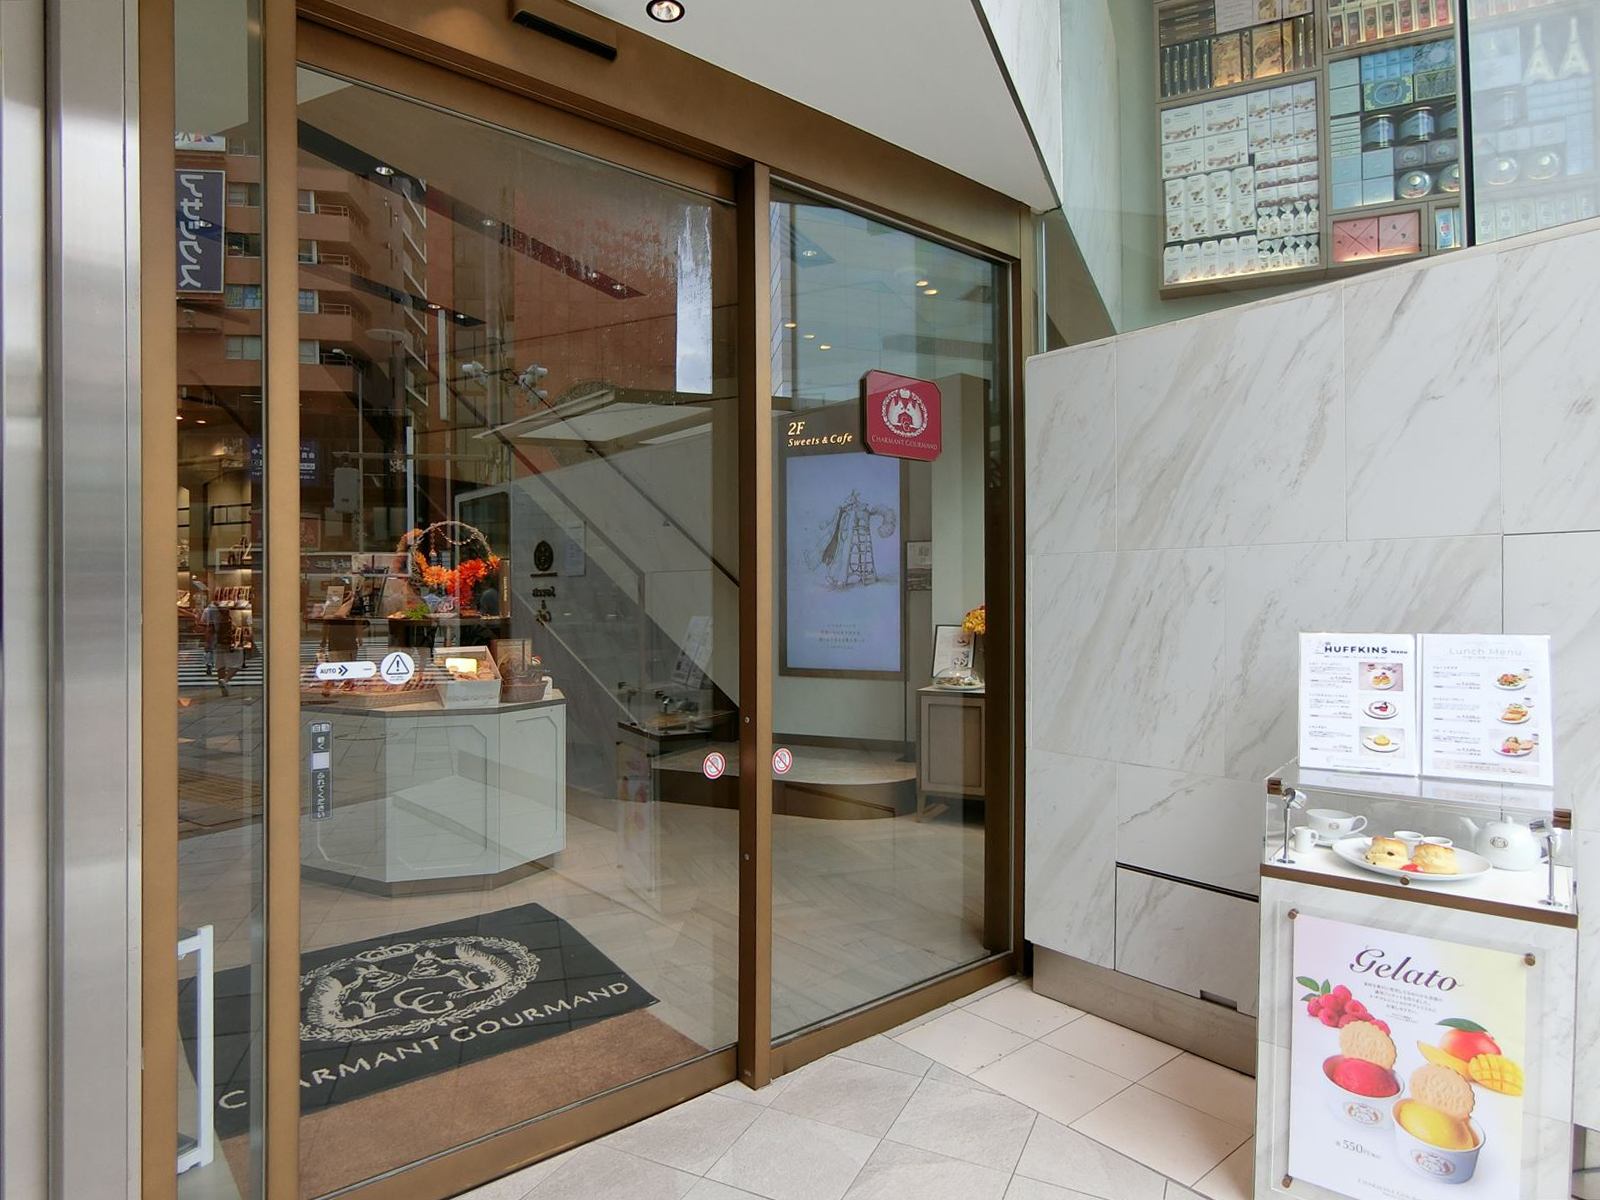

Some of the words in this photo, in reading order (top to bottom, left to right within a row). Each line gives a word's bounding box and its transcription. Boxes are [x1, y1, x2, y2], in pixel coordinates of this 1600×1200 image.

[787, 421, 805, 436] 2F
[787, 437, 820, 447] Sweets
[821, 436, 828, 444] &
[830, 432, 853, 446] Cafe
[1324, 646, 1388, 654] HUFFKINS
[1449, 648, 1485, 656] Lunch
[1489, 648, 1522, 657] Menu
[1349, 945, 1464, 991] Gelato
[449, 982, 629, 1042] GOURMAND
